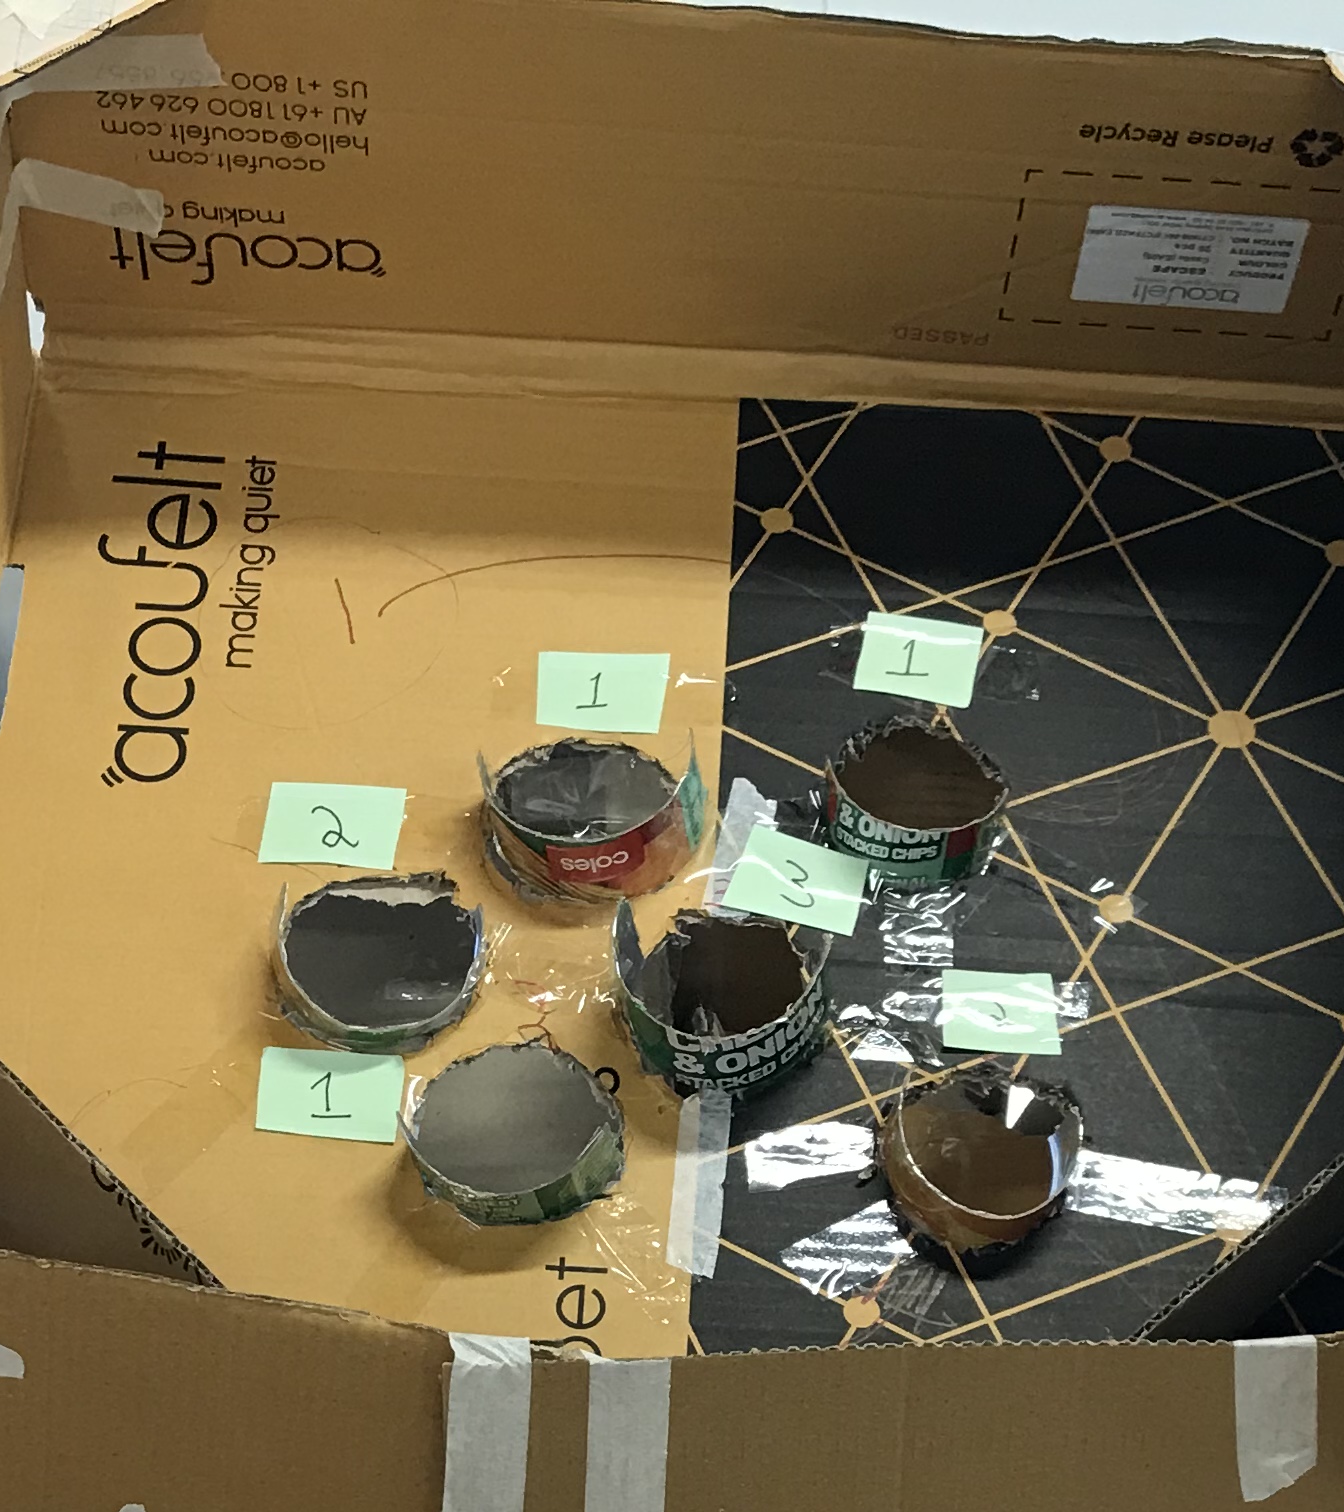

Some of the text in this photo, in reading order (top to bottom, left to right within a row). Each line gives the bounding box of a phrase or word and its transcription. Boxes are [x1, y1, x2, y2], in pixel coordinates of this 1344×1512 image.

[296, 76, 321, 94] +1
[333, 79, 368, 99] US
[95, 90, 367, 126] AU +61 1800 626 462
[101, 118, 369, 156] hello@acoufelt.com
[1078, 122, 1274, 153] Please Recycle
[148, 148, 326, 174] acoufelt.com
[182, 200, 285, 228] making
[109, 226, 387, 285] acoufelt
[1132, 283, 1241, 306] acoufelt
[894, 326, 990, 347] PASSED
[218, 454, 281, 669] making quiet
[97, 440, 226, 788] acoufelt
[884, 638, 930, 677] 1
[575, 671, 608, 710] 1
[310, 804, 360, 848] 2
[838, 802, 943, 845] & ONION
[835, 826, 939, 861] STACKED CHIPS
[559, 850, 630, 874] coles
[672, 1051, 706, 1075] &
[675, 1060, 777, 1091] STACKED
[310, 1072, 352, 1119] 1
